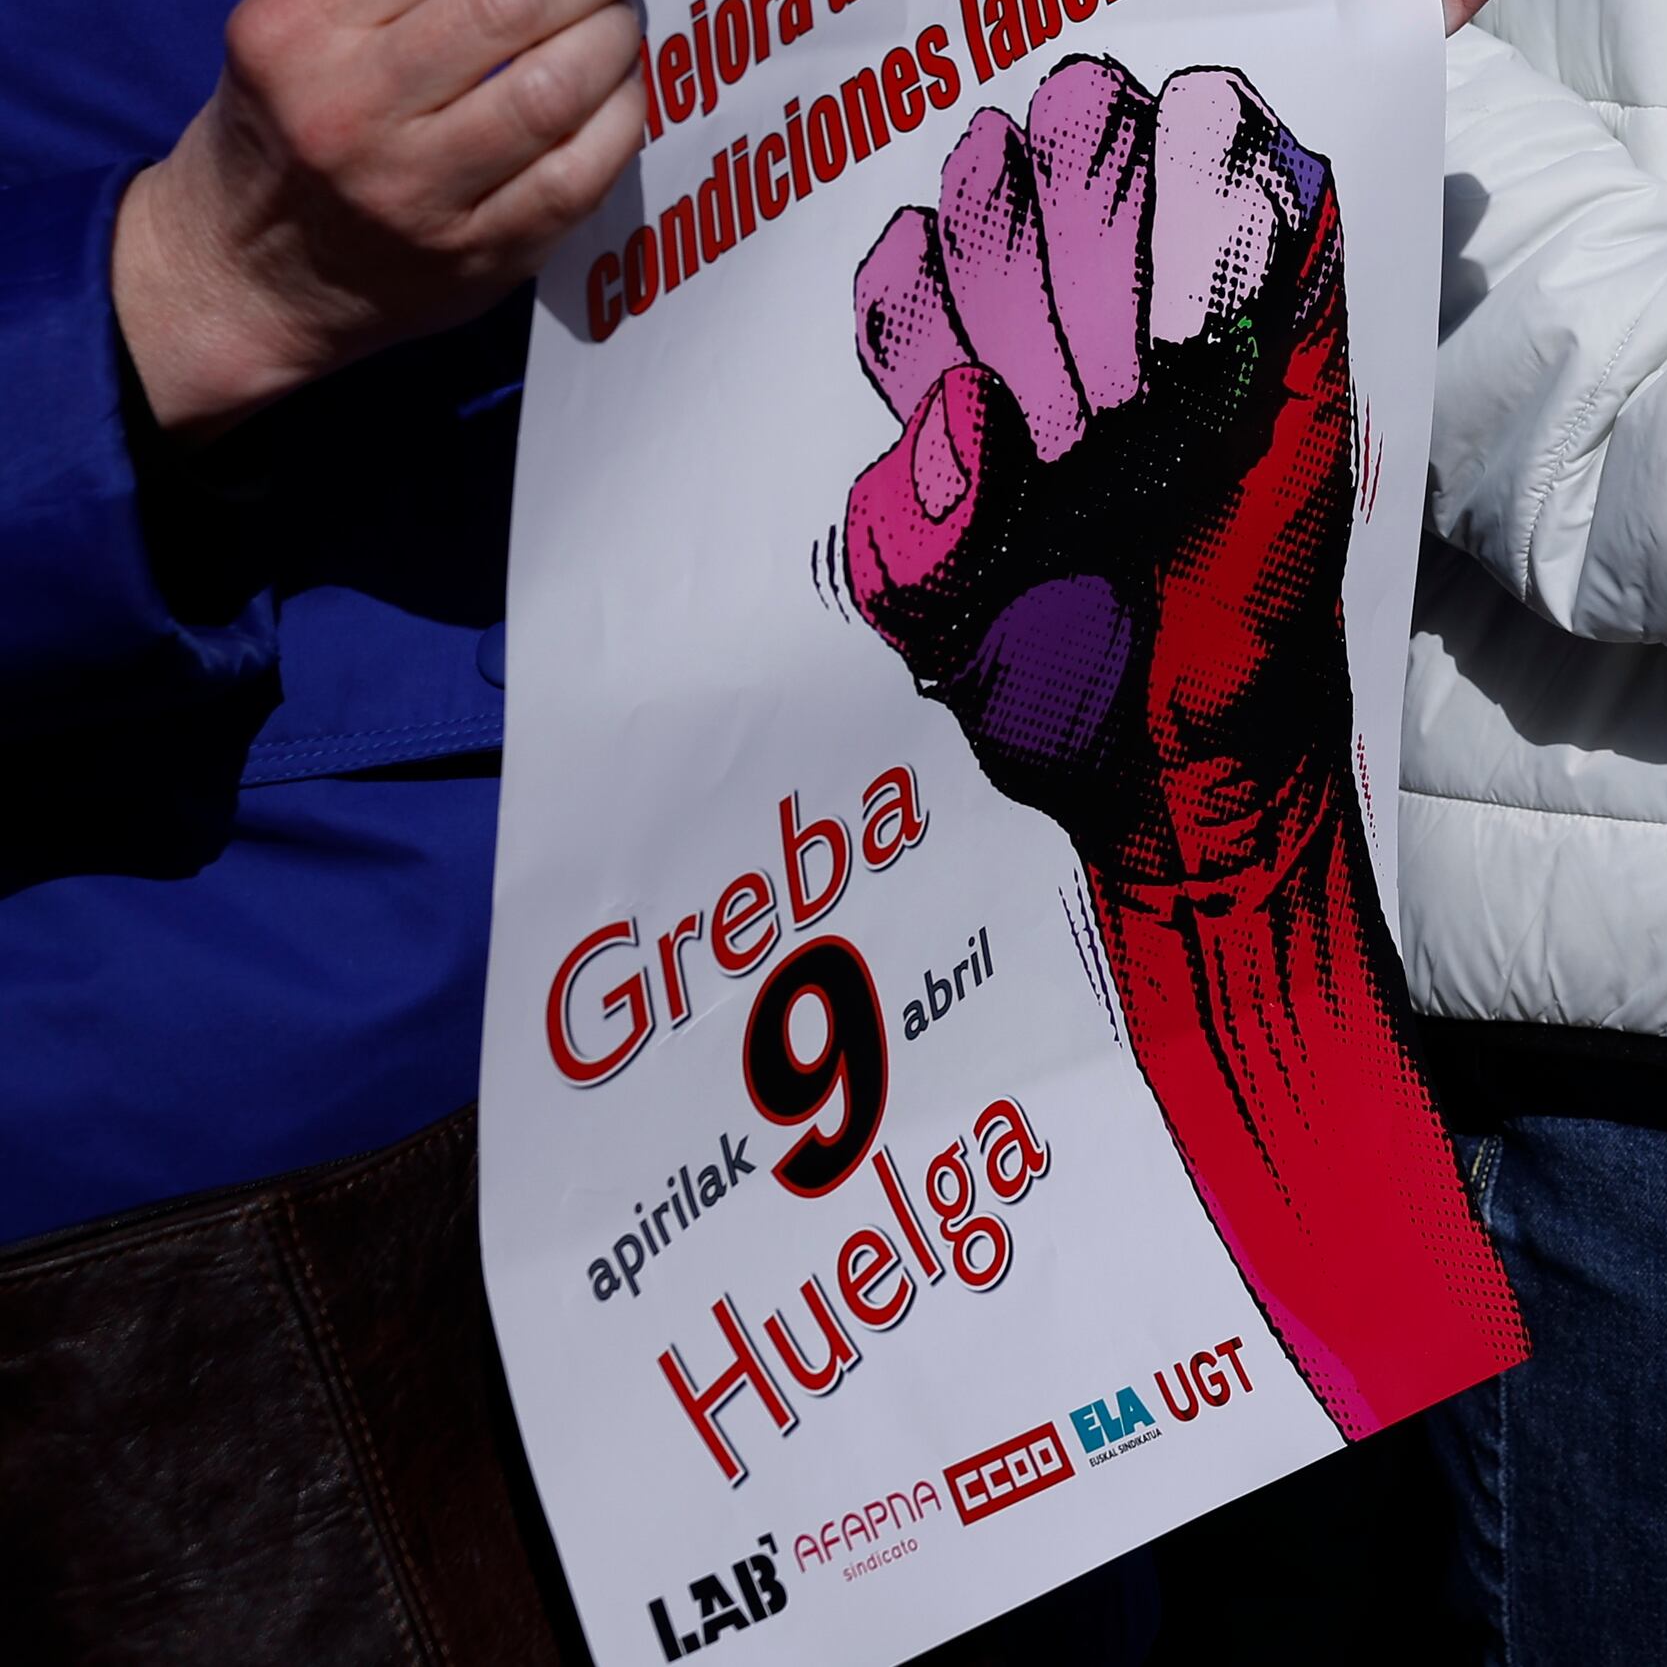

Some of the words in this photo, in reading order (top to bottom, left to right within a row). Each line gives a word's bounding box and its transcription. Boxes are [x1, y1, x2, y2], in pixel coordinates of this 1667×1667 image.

[585, 24, 961, 344] condiciones
[545, 763, 930, 1089] Greba
[586, 1131, 758, 1304] apirilak
[742, 935, 890, 1199] 9
[902, 926, 996, 1042] abril
[657, 1095, 1051, 1489] Huelga
[1069, 1385, 1156, 1454] ELA
[1153, 1336, 1254, 1422] UGT
[955, 1434, 1066, 1511] CCOO
[1089, 1447, 1118, 1468] EUSKAL
[1118, 1427, 1163, 1455] SINDIKATUA
[793, 1479, 942, 1574] AFAPNA
[843, 1537, 919, 1582] sindicato
[647, 1532, 790, 1664] LAB
